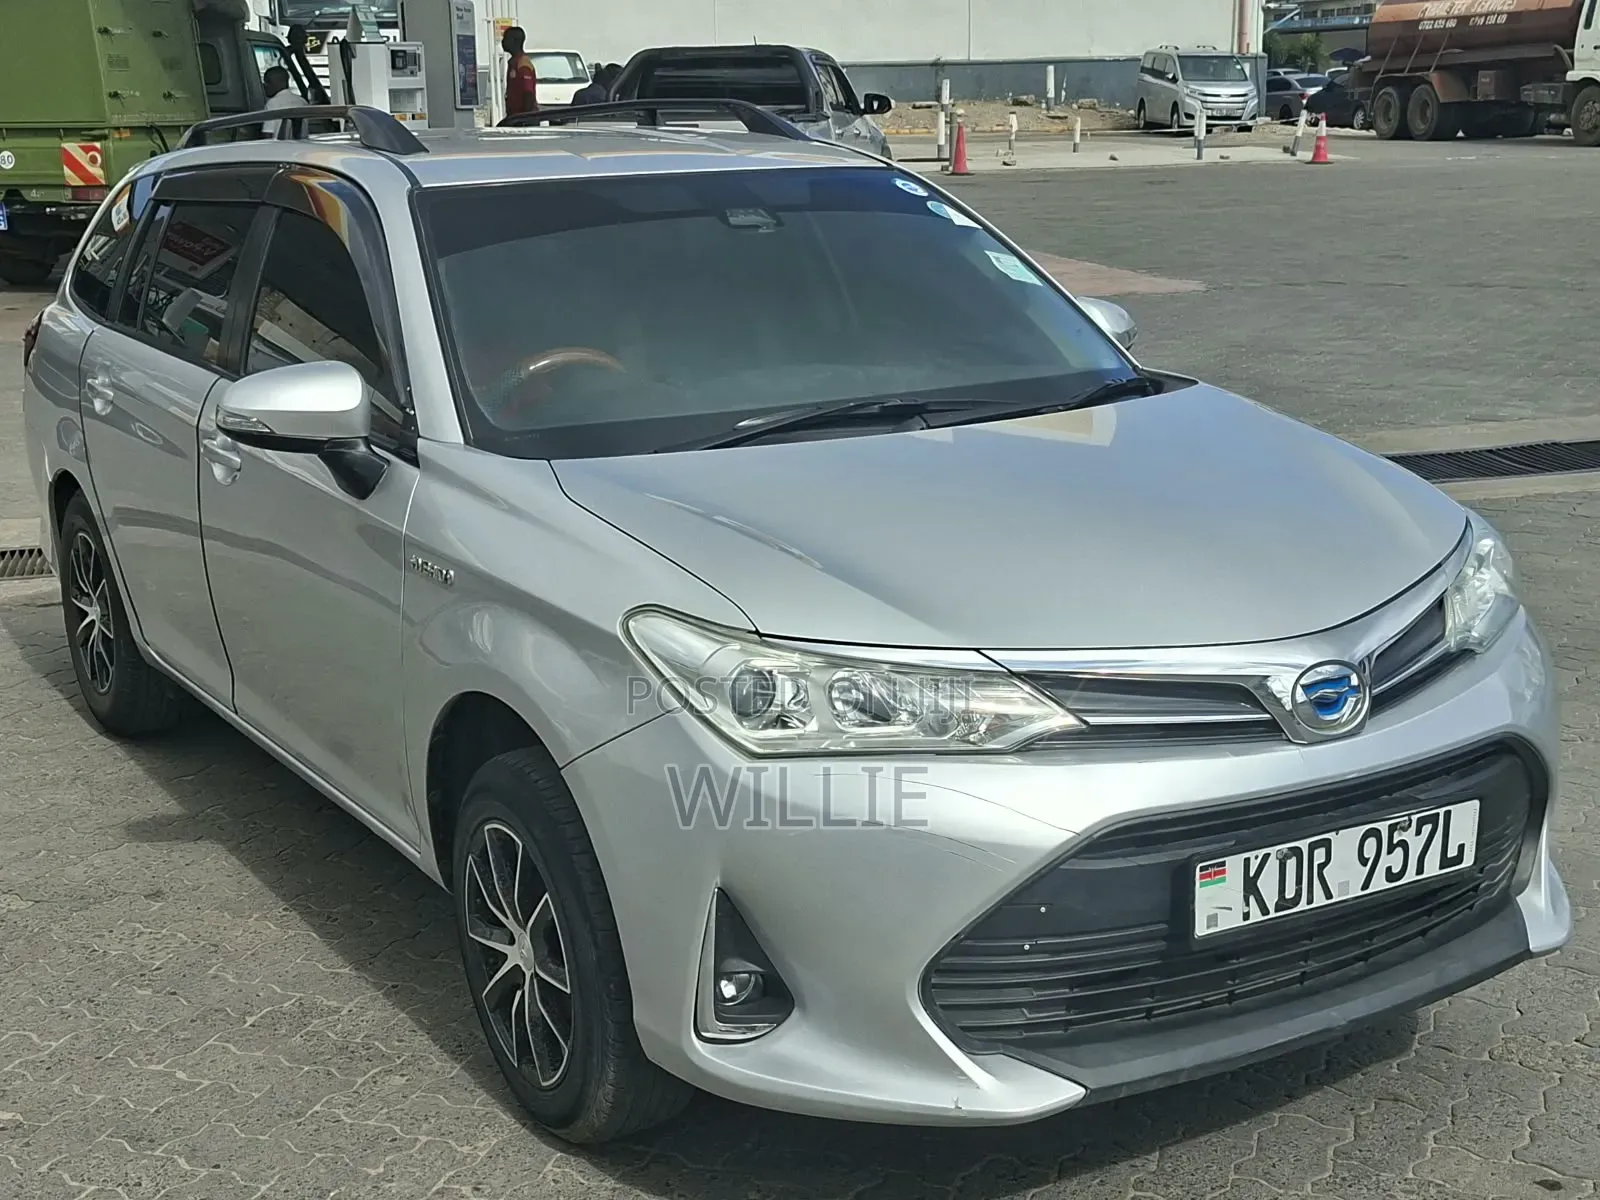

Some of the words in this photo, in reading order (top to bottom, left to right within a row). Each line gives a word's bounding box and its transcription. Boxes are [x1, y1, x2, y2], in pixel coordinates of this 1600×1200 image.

[0, 154, 13, 165] 80
[1242, 837, 1334, 922] KDR
[1357, 809, 1466, 892] 957L
